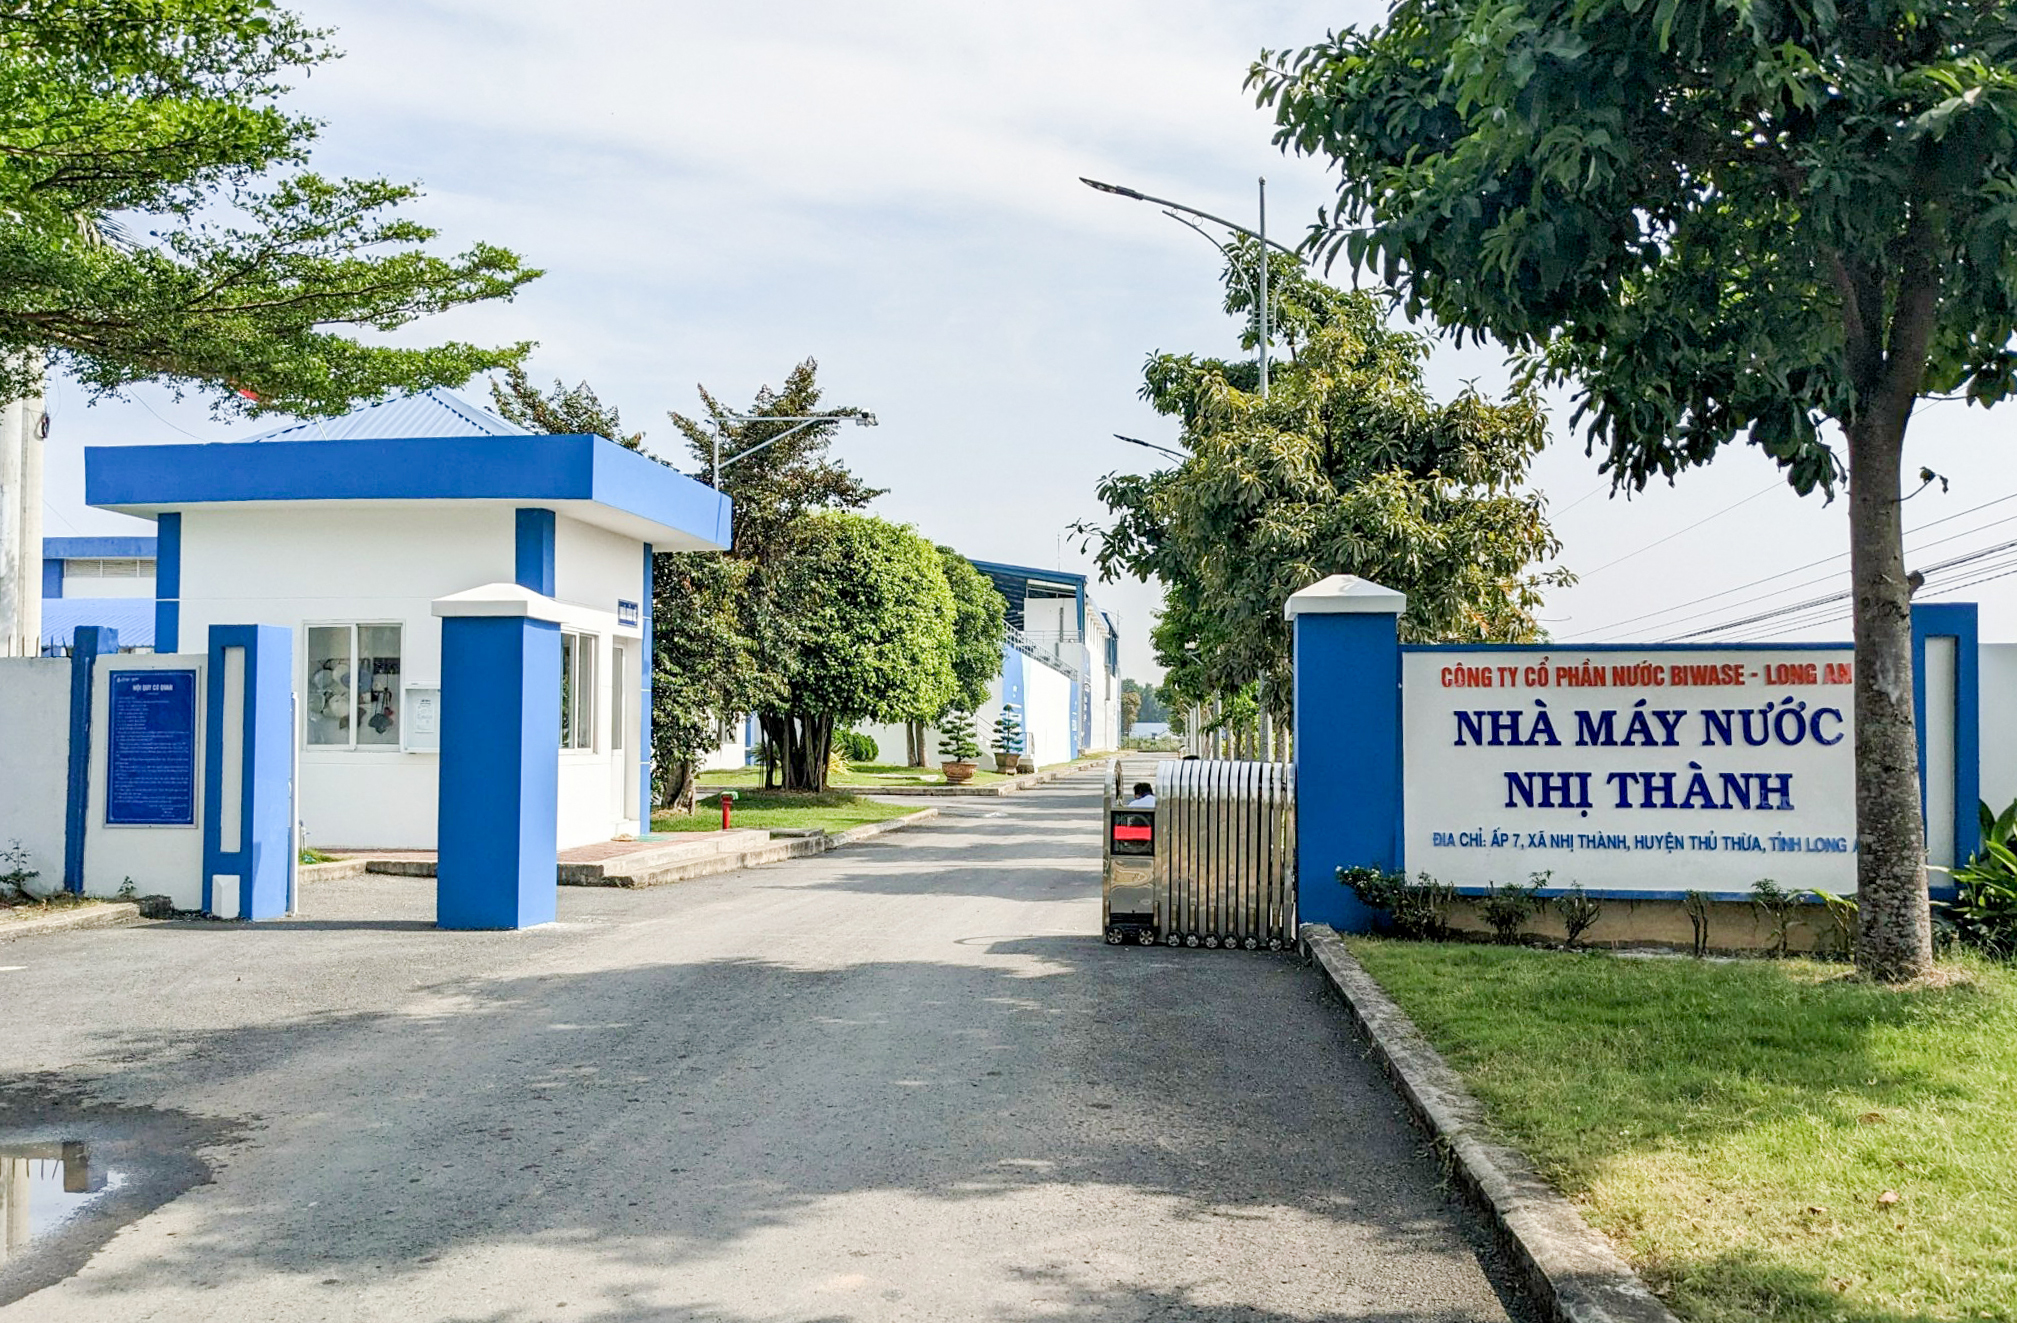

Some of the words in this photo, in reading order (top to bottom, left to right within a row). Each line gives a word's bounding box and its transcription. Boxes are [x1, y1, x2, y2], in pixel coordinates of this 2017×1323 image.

[1440, 662, 1493, 687] CÔNG
[1497, 667, 1519, 687] TY
[1524, 656, 1549, 687] CỔ
[1555, 658, 1606, 687] PHẦN
[1612, 660, 1665, 687] NƯỚC
[1671, 664, 1745, 686] BIWASE
[1765, 663, 1818, 686] LONG
[1823, 663, 1852, 684] AN
[1454, 699, 1562, 746] NHÀ
[1574, 698, 1687, 746] MÁY
[1702, 696, 1844, 746] NƯỚC
[1504, 772, 1593, 817] NHỊ
[1605, 761, 1795, 810] THÀNH
[1459, 827, 1486, 848] CHỈ:
[1491, 827, 1509, 848] ẤP
[1513, 834, 1524, 850] 7,
[1528, 831, 1547, 849] XÃ
[1550, 833, 1574, 852] NHỊ
[1578, 831, 1630, 851] THÀNH,
[1635, 832, 1684, 853] HUYỆN
[1690, 831, 1717, 850] THỦ
[1722, 833, 1766, 853] THỪA,
[1769, 832, 1801, 851] TỈNH
[1805, 837, 1847, 852] LONG
